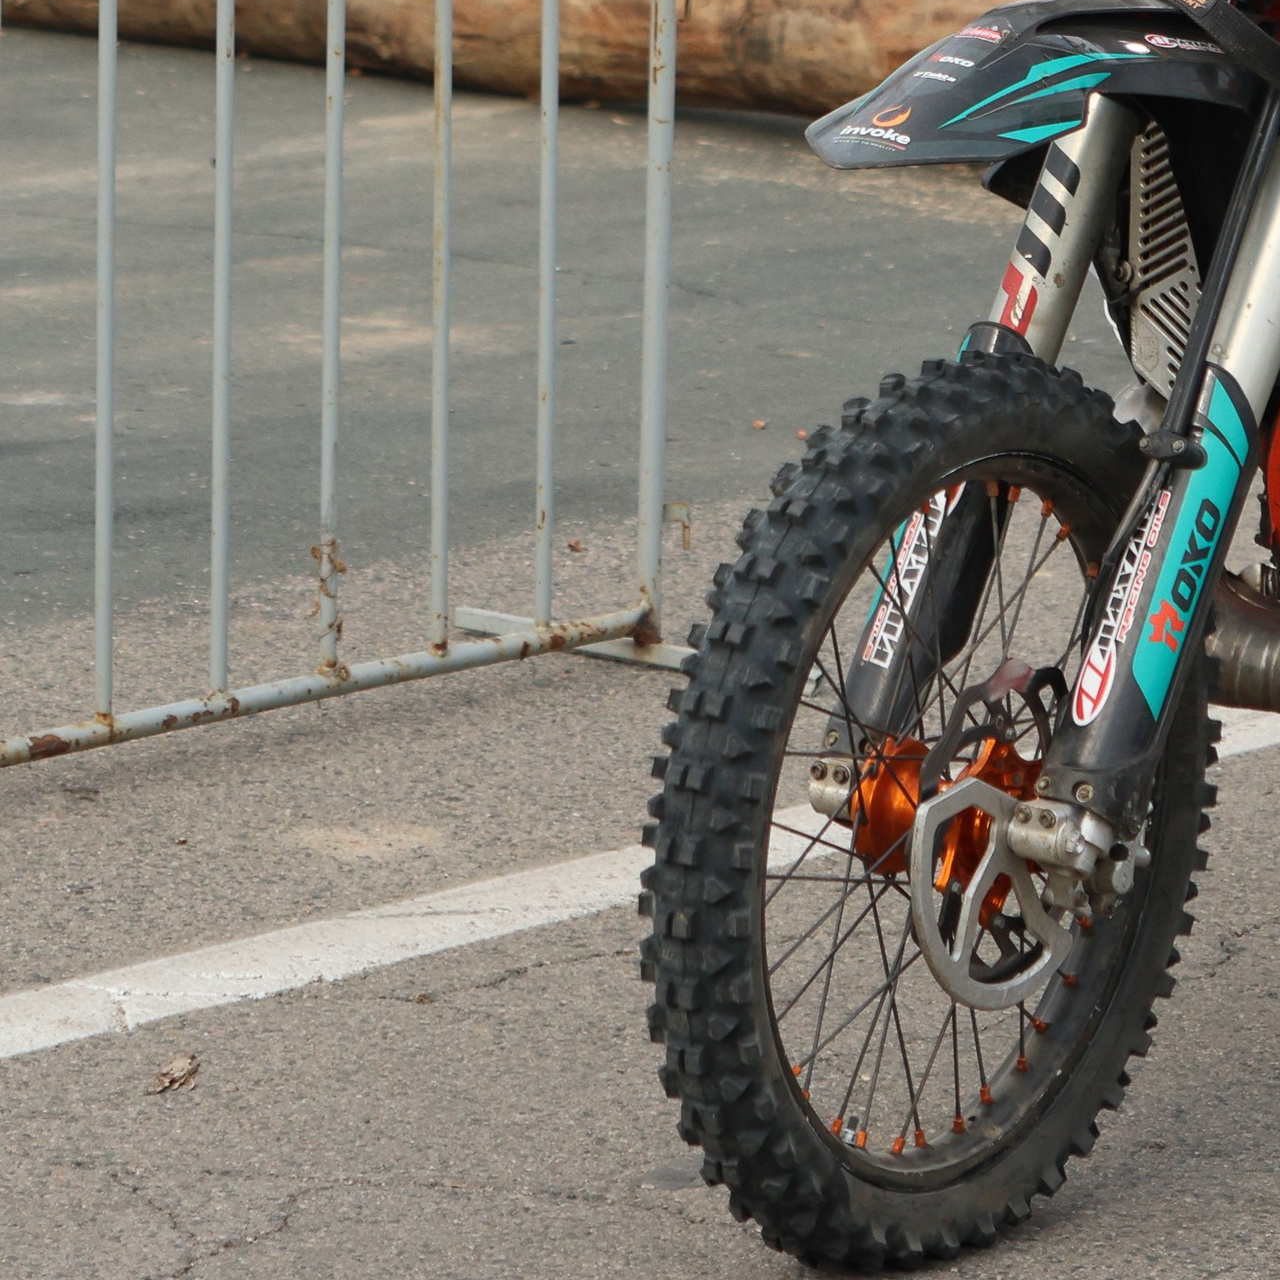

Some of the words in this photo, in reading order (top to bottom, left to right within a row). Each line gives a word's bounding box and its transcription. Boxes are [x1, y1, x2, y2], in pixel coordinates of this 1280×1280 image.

[840, 125, 911, 145] invoke
[1116, 552, 1152, 644] RACING
[1146, 489, 1172, 548] OILS
[1148, 498, 1222, 654] ROXO
[862, 604, 887, 661] OILS
